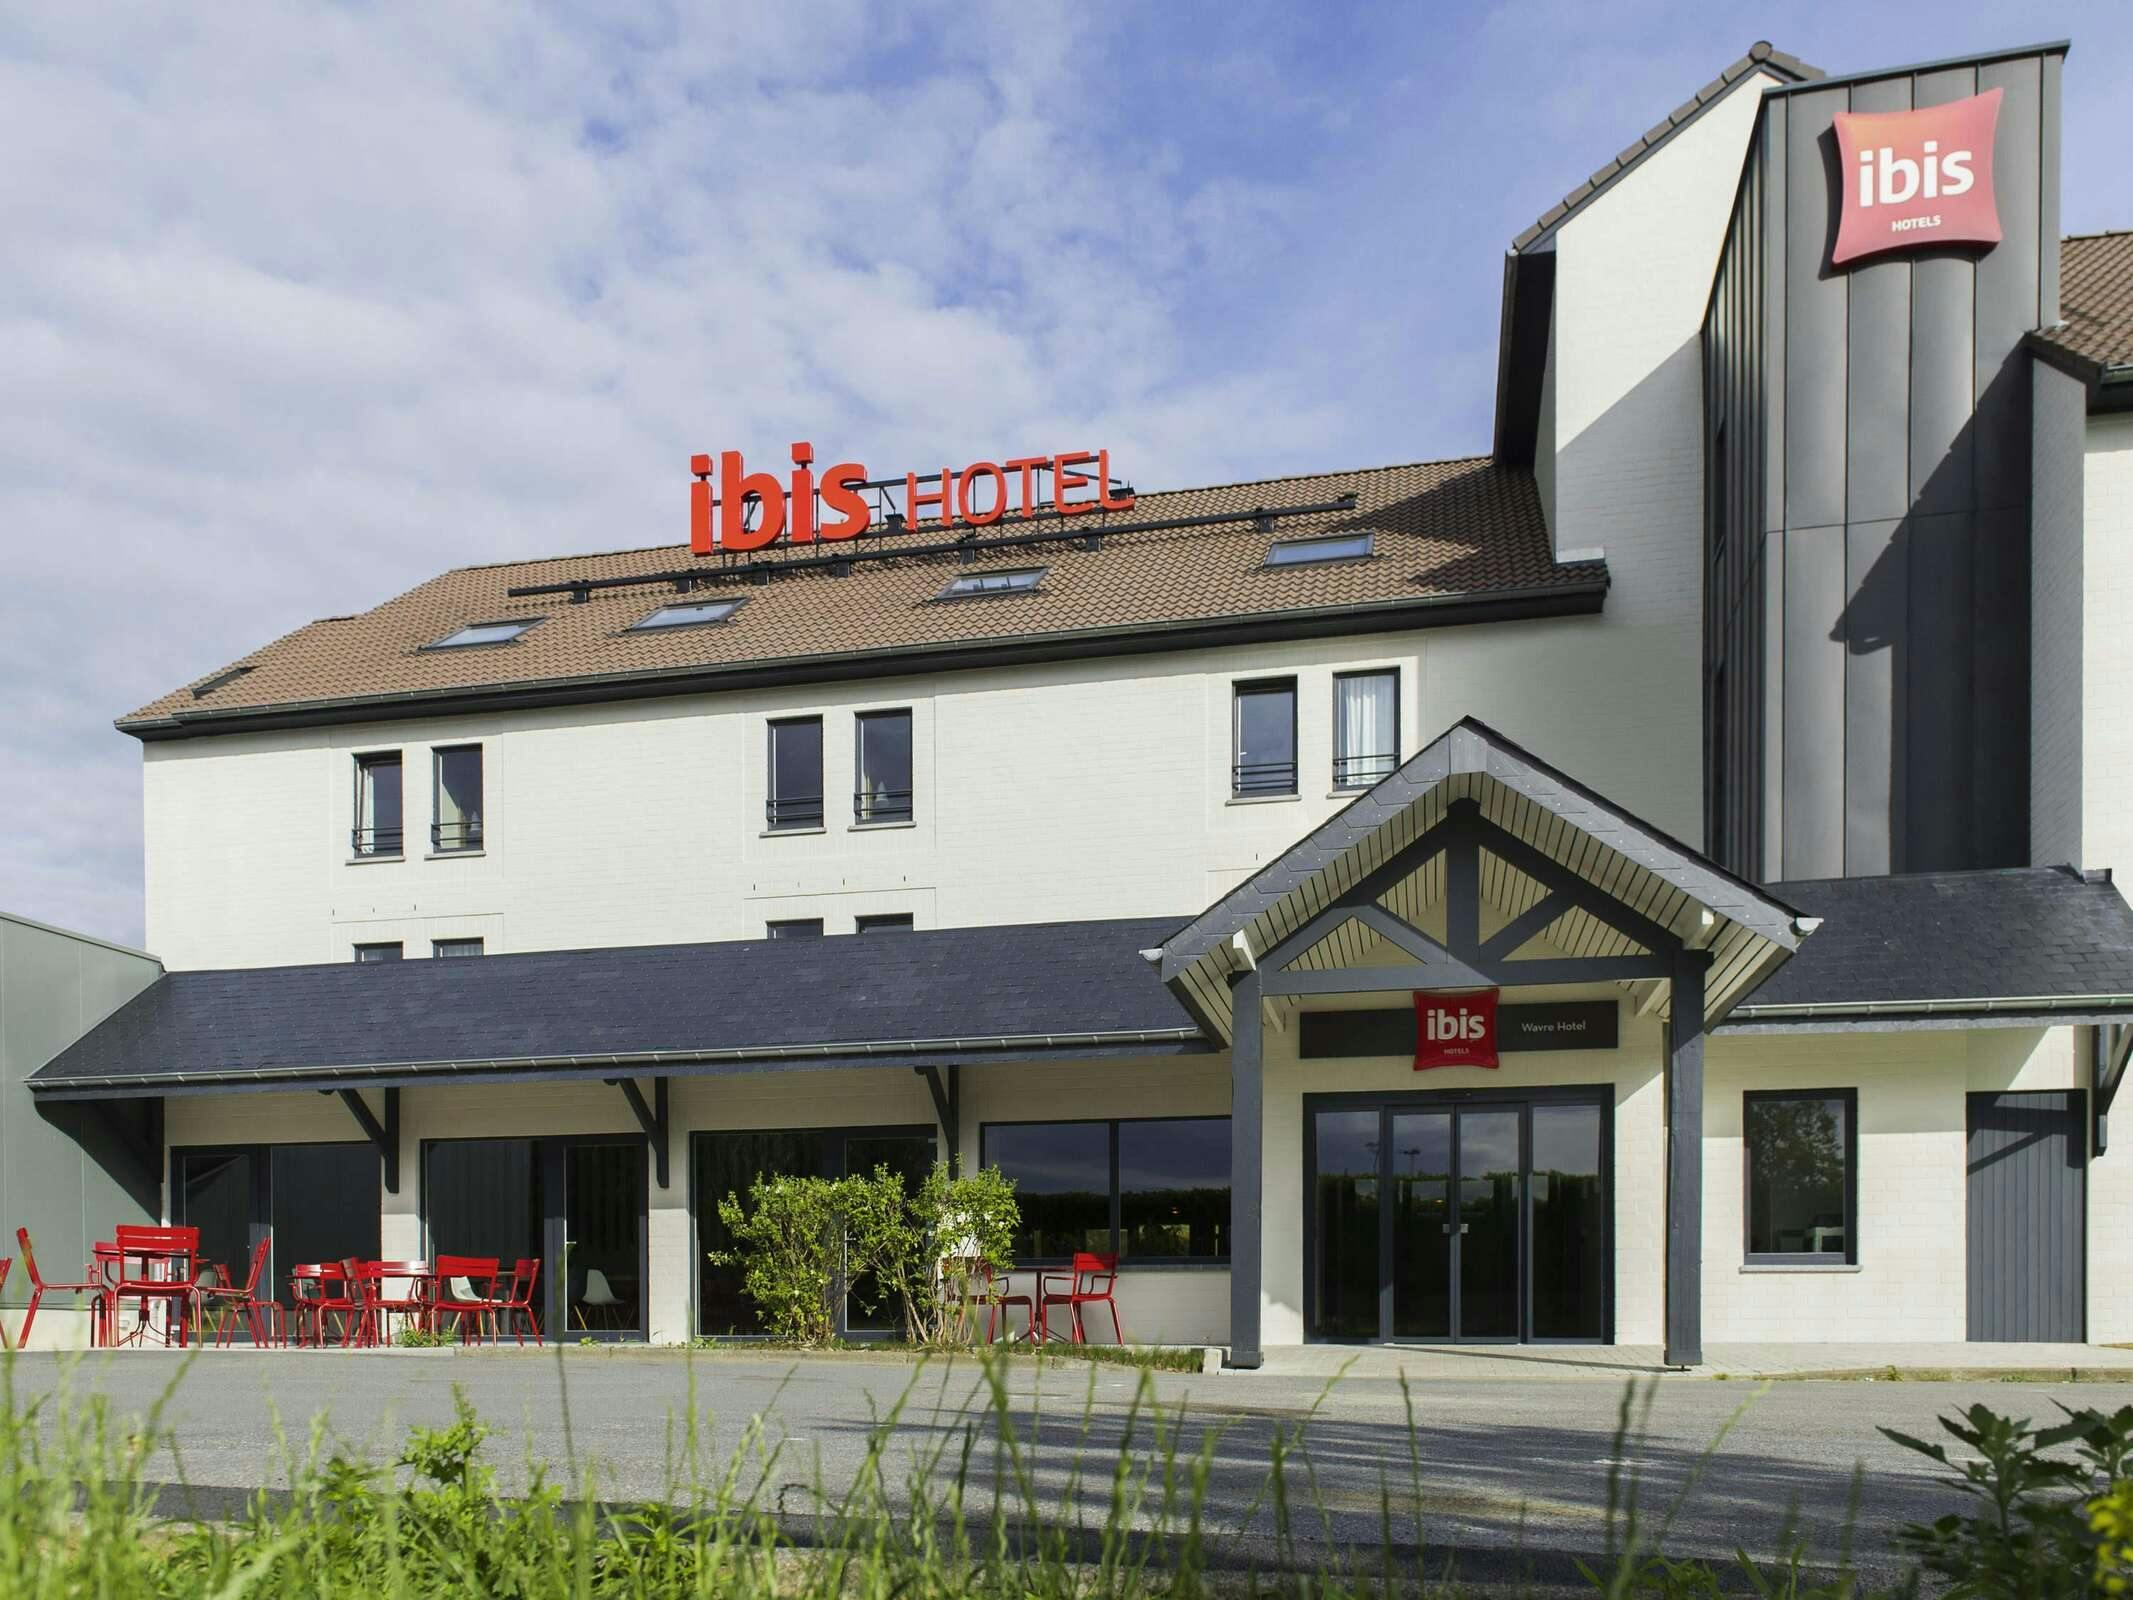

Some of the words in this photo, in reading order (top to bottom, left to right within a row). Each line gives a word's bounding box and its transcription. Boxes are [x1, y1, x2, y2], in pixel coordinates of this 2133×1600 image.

[1859, 140, 1975, 207] ibis
[1891, 215, 1942, 232] HOTELS
[690, 441, 871, 557] ibis
[906, 448, 1136, 534] HOTEL
[1427, 1008, 1486, 1041] ibis
[1521, 1022, 1555, 1033] Wavre
[1556, 1020, 1587, 1032] Hotel
[1444, 1047, 1470, 1056] HOTELS
